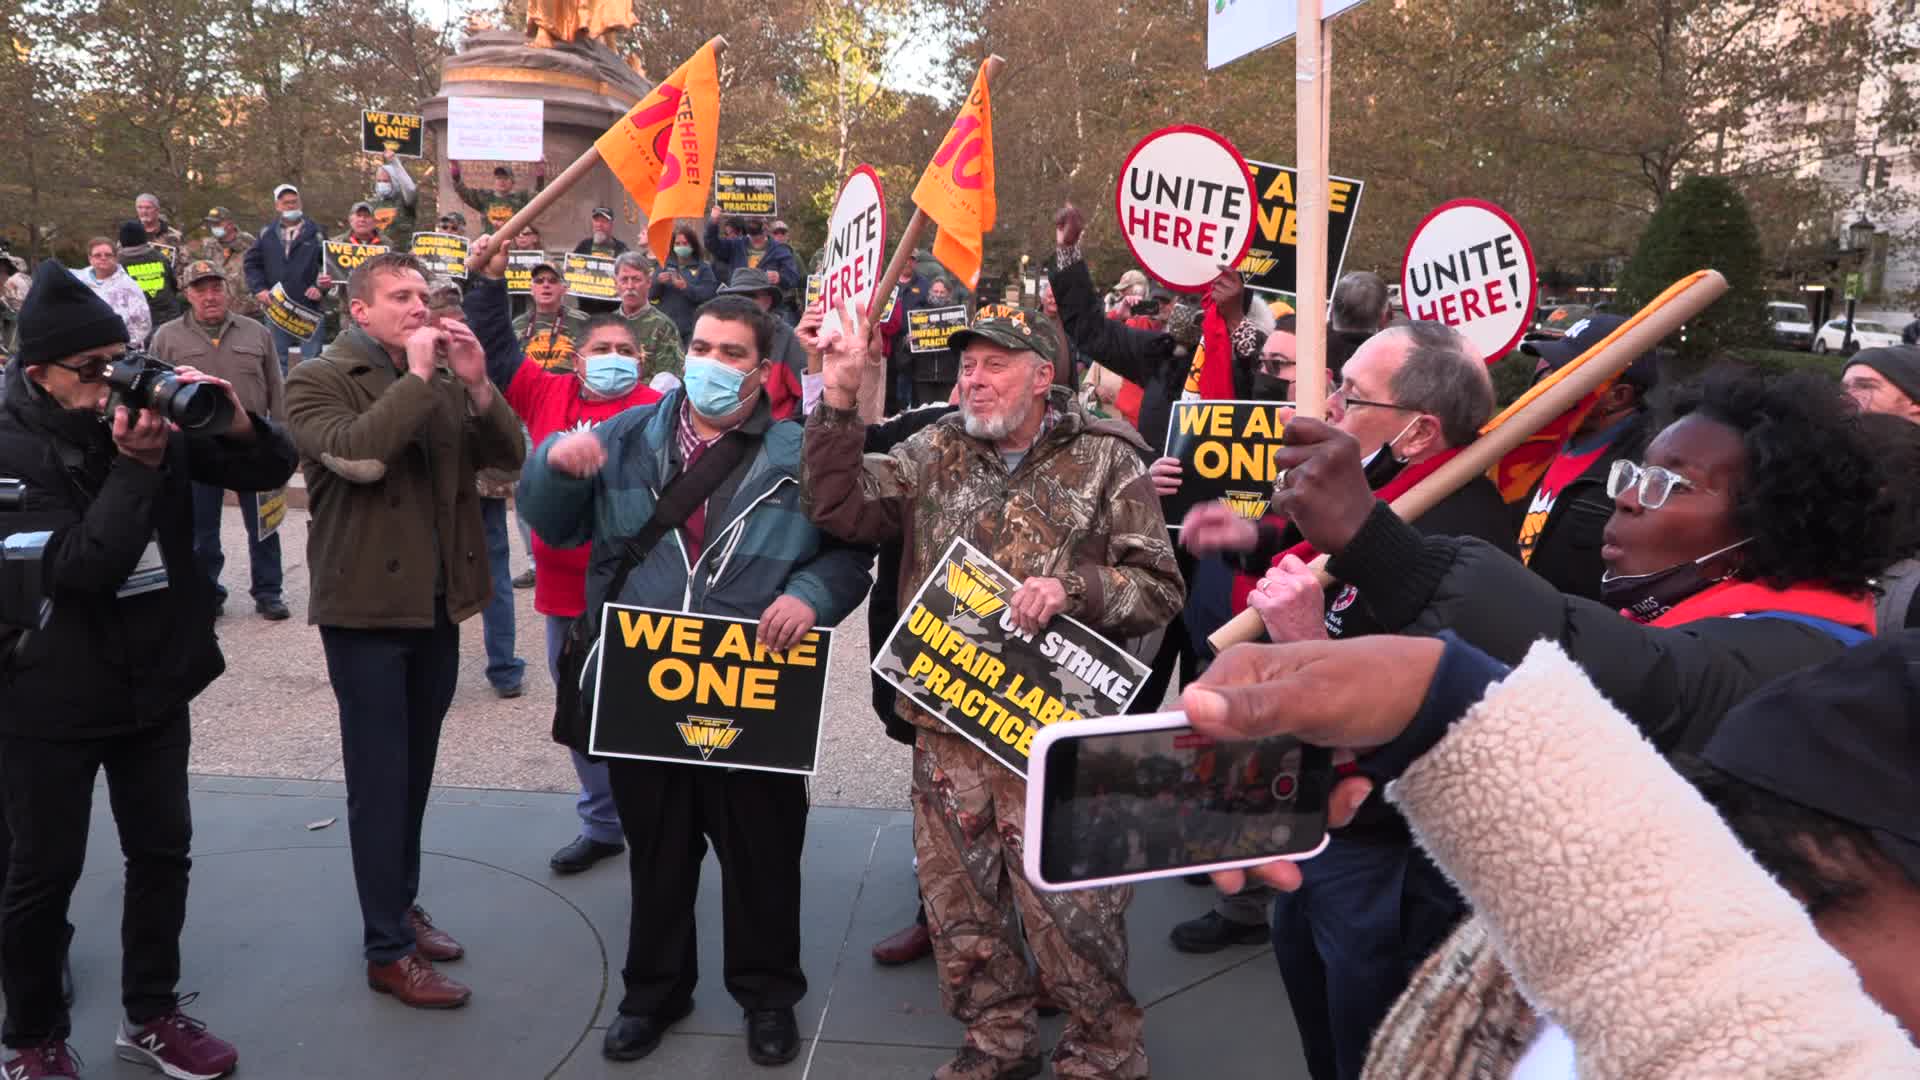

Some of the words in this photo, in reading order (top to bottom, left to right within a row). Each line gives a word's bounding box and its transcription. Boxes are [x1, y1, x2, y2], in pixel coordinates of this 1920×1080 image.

[366, 111, 388, 125] WE
[392, 115, 420, 129] ARE
[374, 124, 410, 140] ONE
[679, 123, 700, 185] HERE!
[1130, 167, 1245, 221] UNITE
[1263, 171, 1353, 214] AE
[328, 243, 352, 255] WE
[356, 246, 385, 257] ARE
[822, 202, 878, 273] UNITE
[1128, 205, 1235, 261] HERE!
[337, 254, 366, 269] ON
[1409, 233, 1519, 298] UNITE
[1417, 272, 1523, 328] HERE!
[1179, 405, 1235, 437] WE
[947, 561, 1005, 617] UMWA
[617, 610, 704, 656] WE
[907, 606, 1007, 689] UNFAIR
[648, 657, 780, 711] ONE
[1039, 631, 1134, 705] STRIKE
[908, 652, 1039, 758] PRACTICE
[680, 725, 738, 748] UMWA
